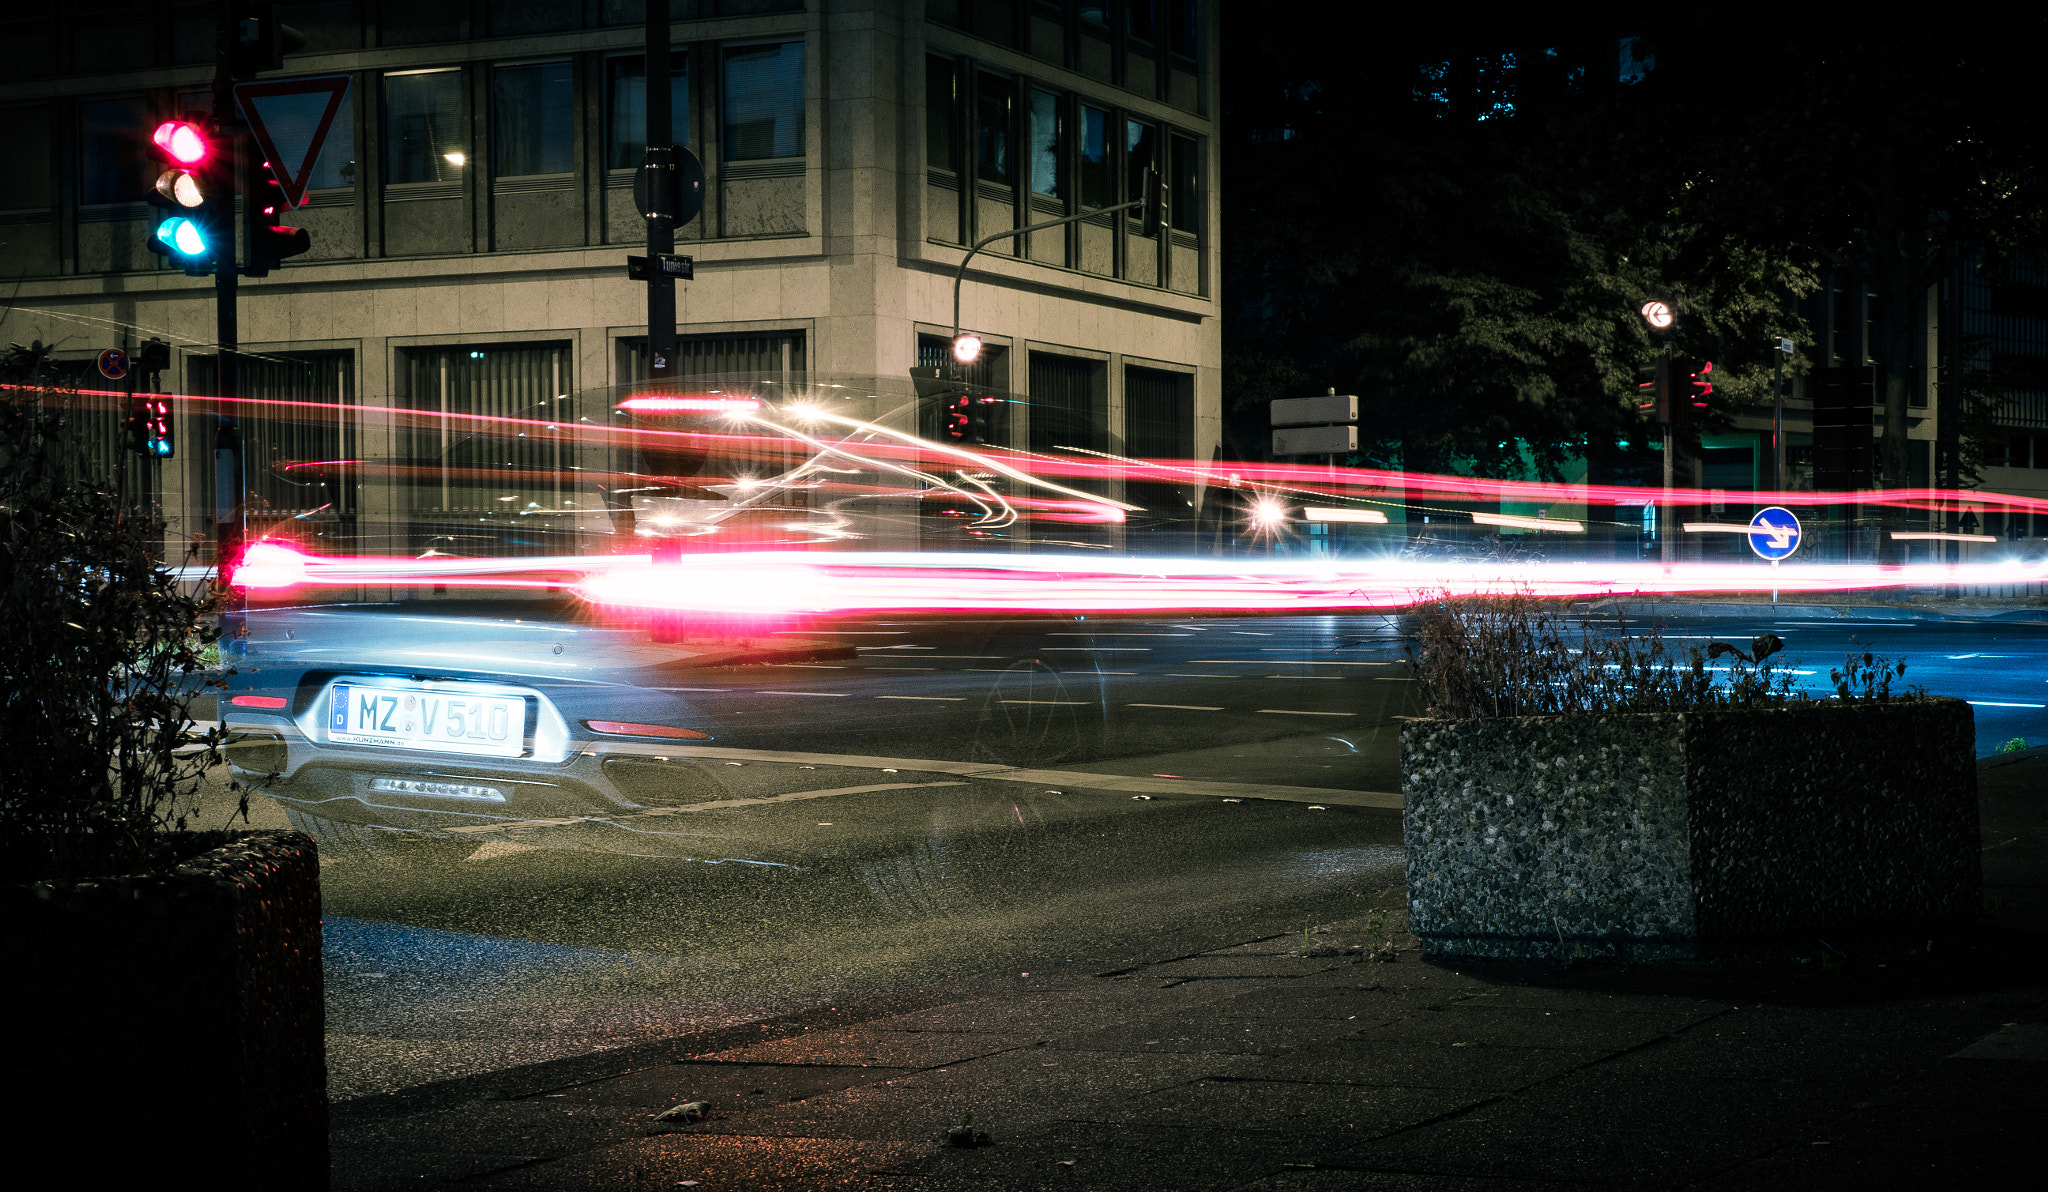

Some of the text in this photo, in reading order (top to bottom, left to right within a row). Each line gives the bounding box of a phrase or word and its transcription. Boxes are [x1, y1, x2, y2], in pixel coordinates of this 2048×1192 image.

[337, 693, 509, 741] D MZ V 510
